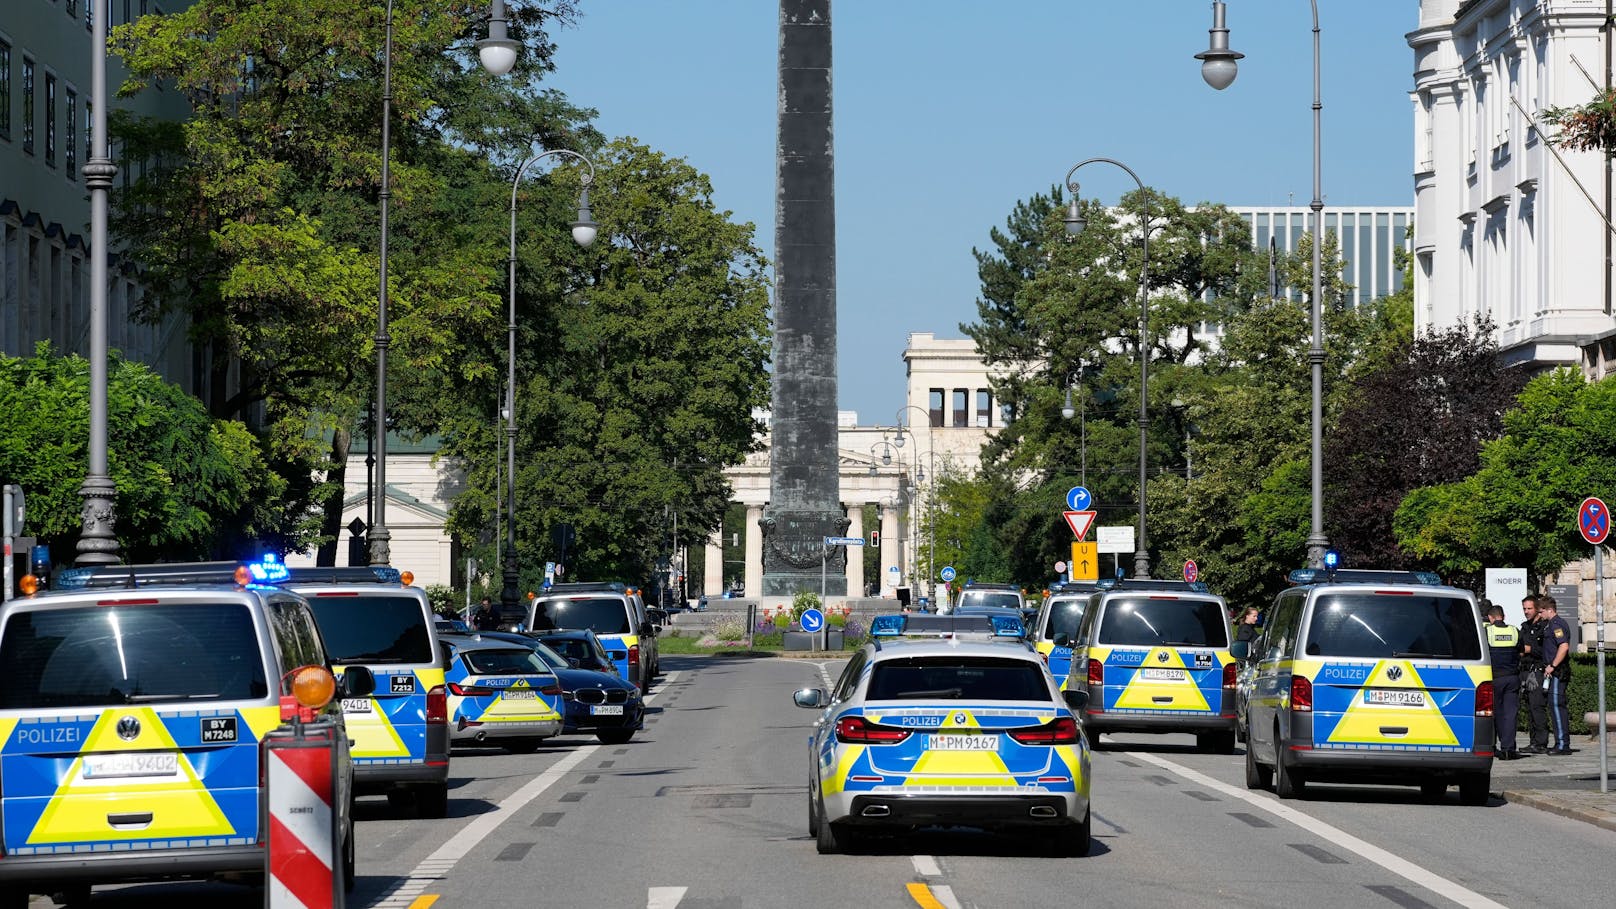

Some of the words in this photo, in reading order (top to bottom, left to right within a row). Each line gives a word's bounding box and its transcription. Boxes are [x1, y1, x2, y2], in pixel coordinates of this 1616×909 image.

[1081, 545, 1088, 554] U
[1497, 577, 1522, 585] NOERR
[1111, 654, 1142, 662] POLIZEI
[1325, 668, 1366, 679] POLIZEI
[1370, 691, 1378, 701] M
[1384, 692, 1397, 702] PM
[1398, 693, 1423, 703] 9166
[210, 720, 227, 729] BY
[902, 716, 940, 726] POLIZEI
[18, 727, 80, 744] POLIZEI
[930, 737, 938, 749] M
[947, 737, 963, 749] PM
[965, 737, 997, 749] 9167
[137, 756, 174, 770] 9402
